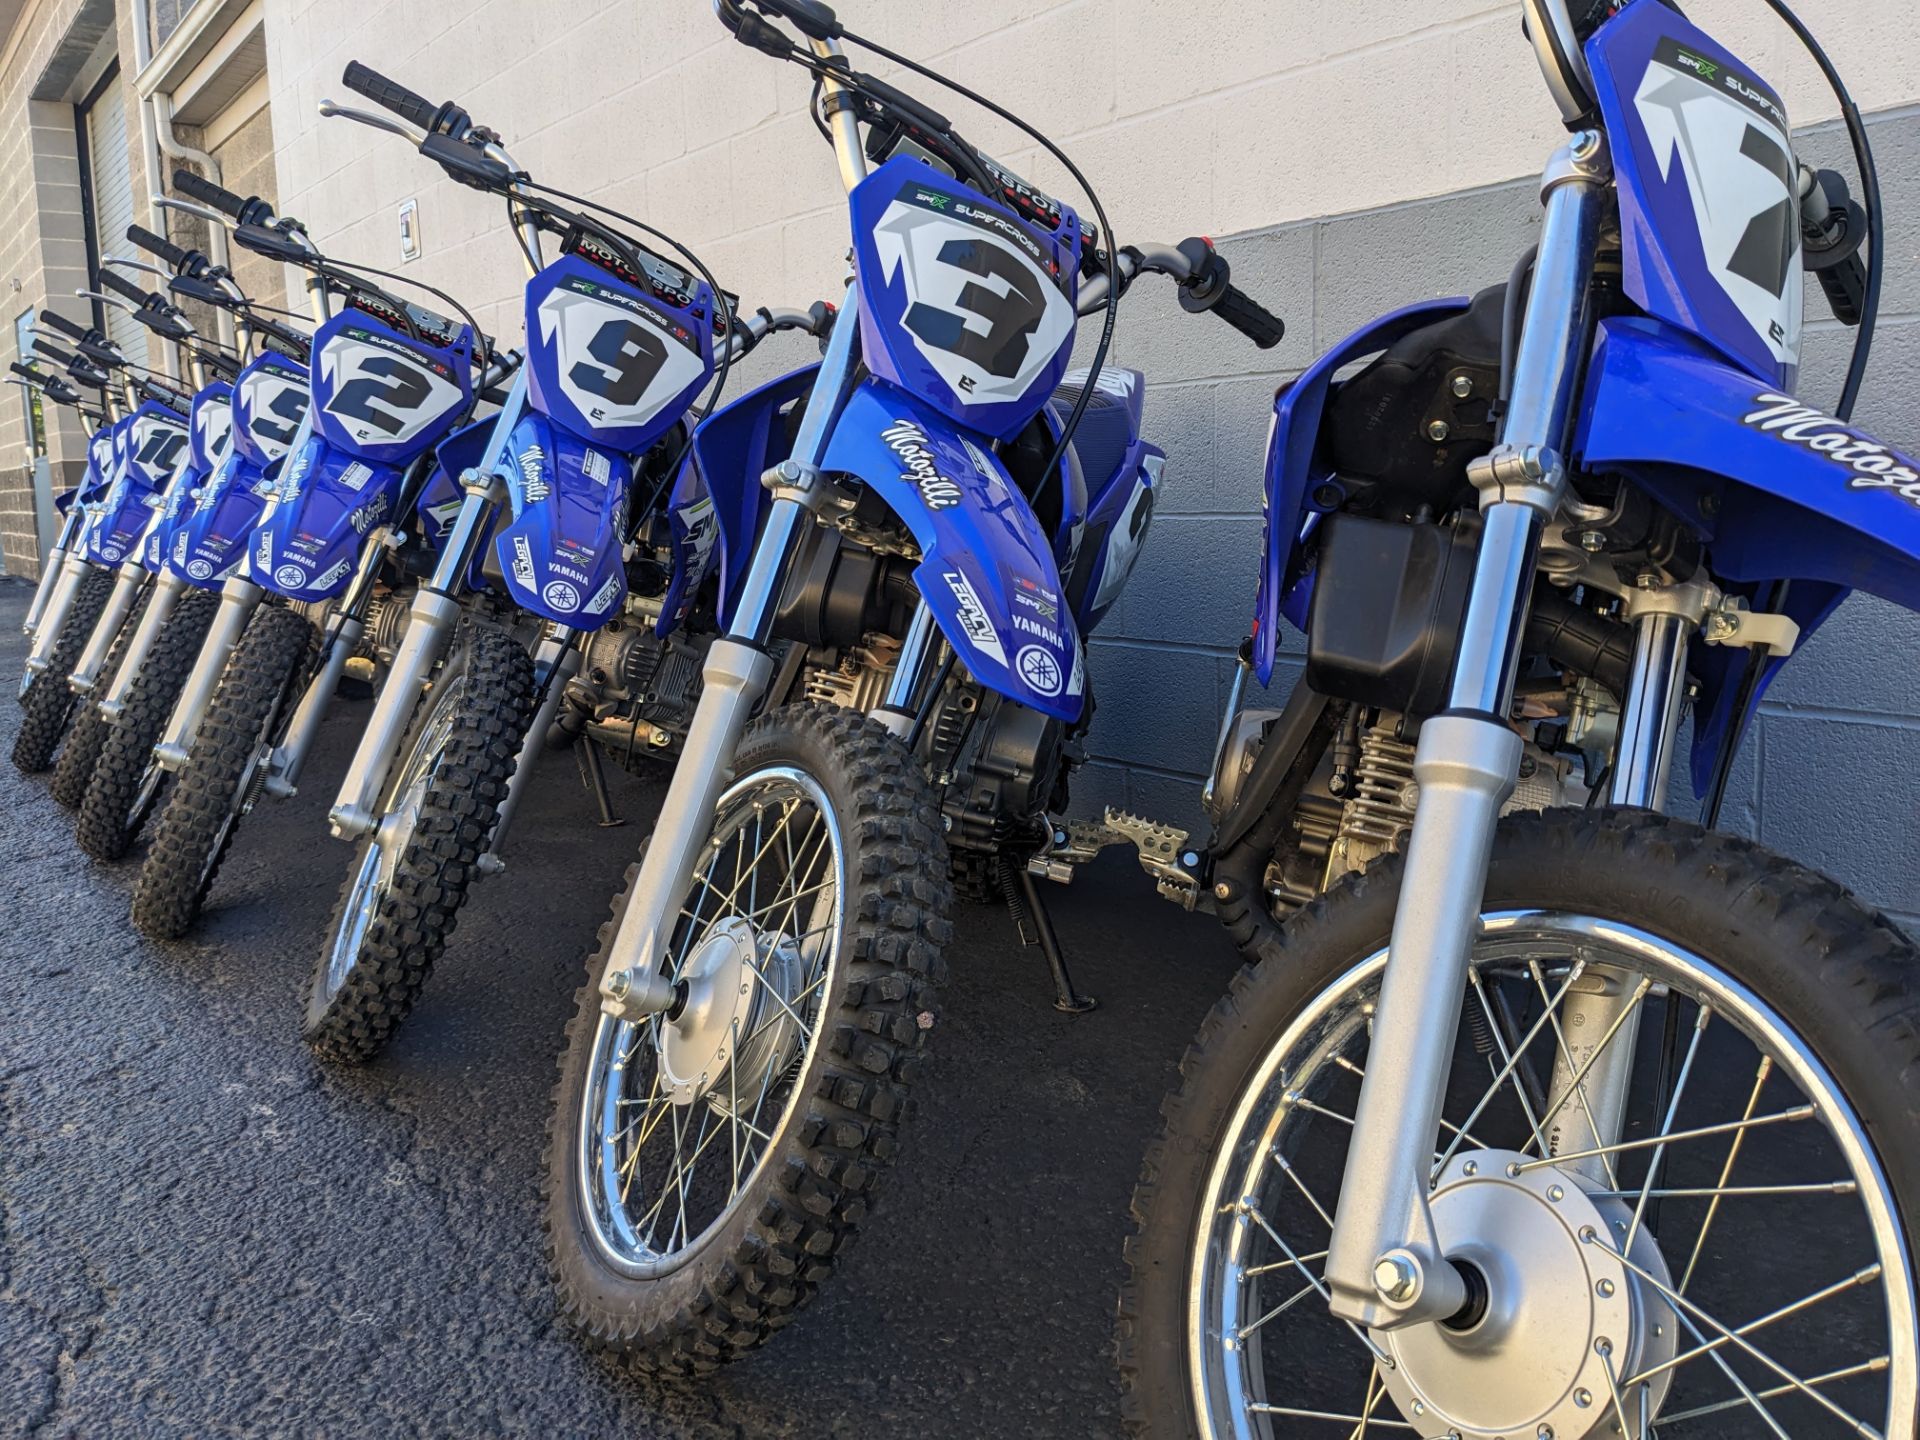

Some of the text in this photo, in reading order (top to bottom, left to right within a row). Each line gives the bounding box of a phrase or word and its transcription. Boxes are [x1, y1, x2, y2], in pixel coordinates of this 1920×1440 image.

[1677, 52, 1717, 80] SMX
[915, 190, 1041, 257] SMX SUPERCROSS
[599, 289, 668, 326] SUPERCROSS
[904, 239, 1048, 379] 3
[369, 335, 428, 364] SUPERCROSS
[568, 319, 669, 406] 9
[326, 356, 433, 436] 2
[881, 419, 961, 509] Motozilli
[195, 548, 223, 564] YAMAHA
[282, 551, 317, 569] YAMAHA
[513, 537, 534, 580] LEGACY
[548, 562, 589, 587] YAMAHA
[943, 573, 997, 643] LEGACY
[1012, 614, 1065, 652] YAMAHA
